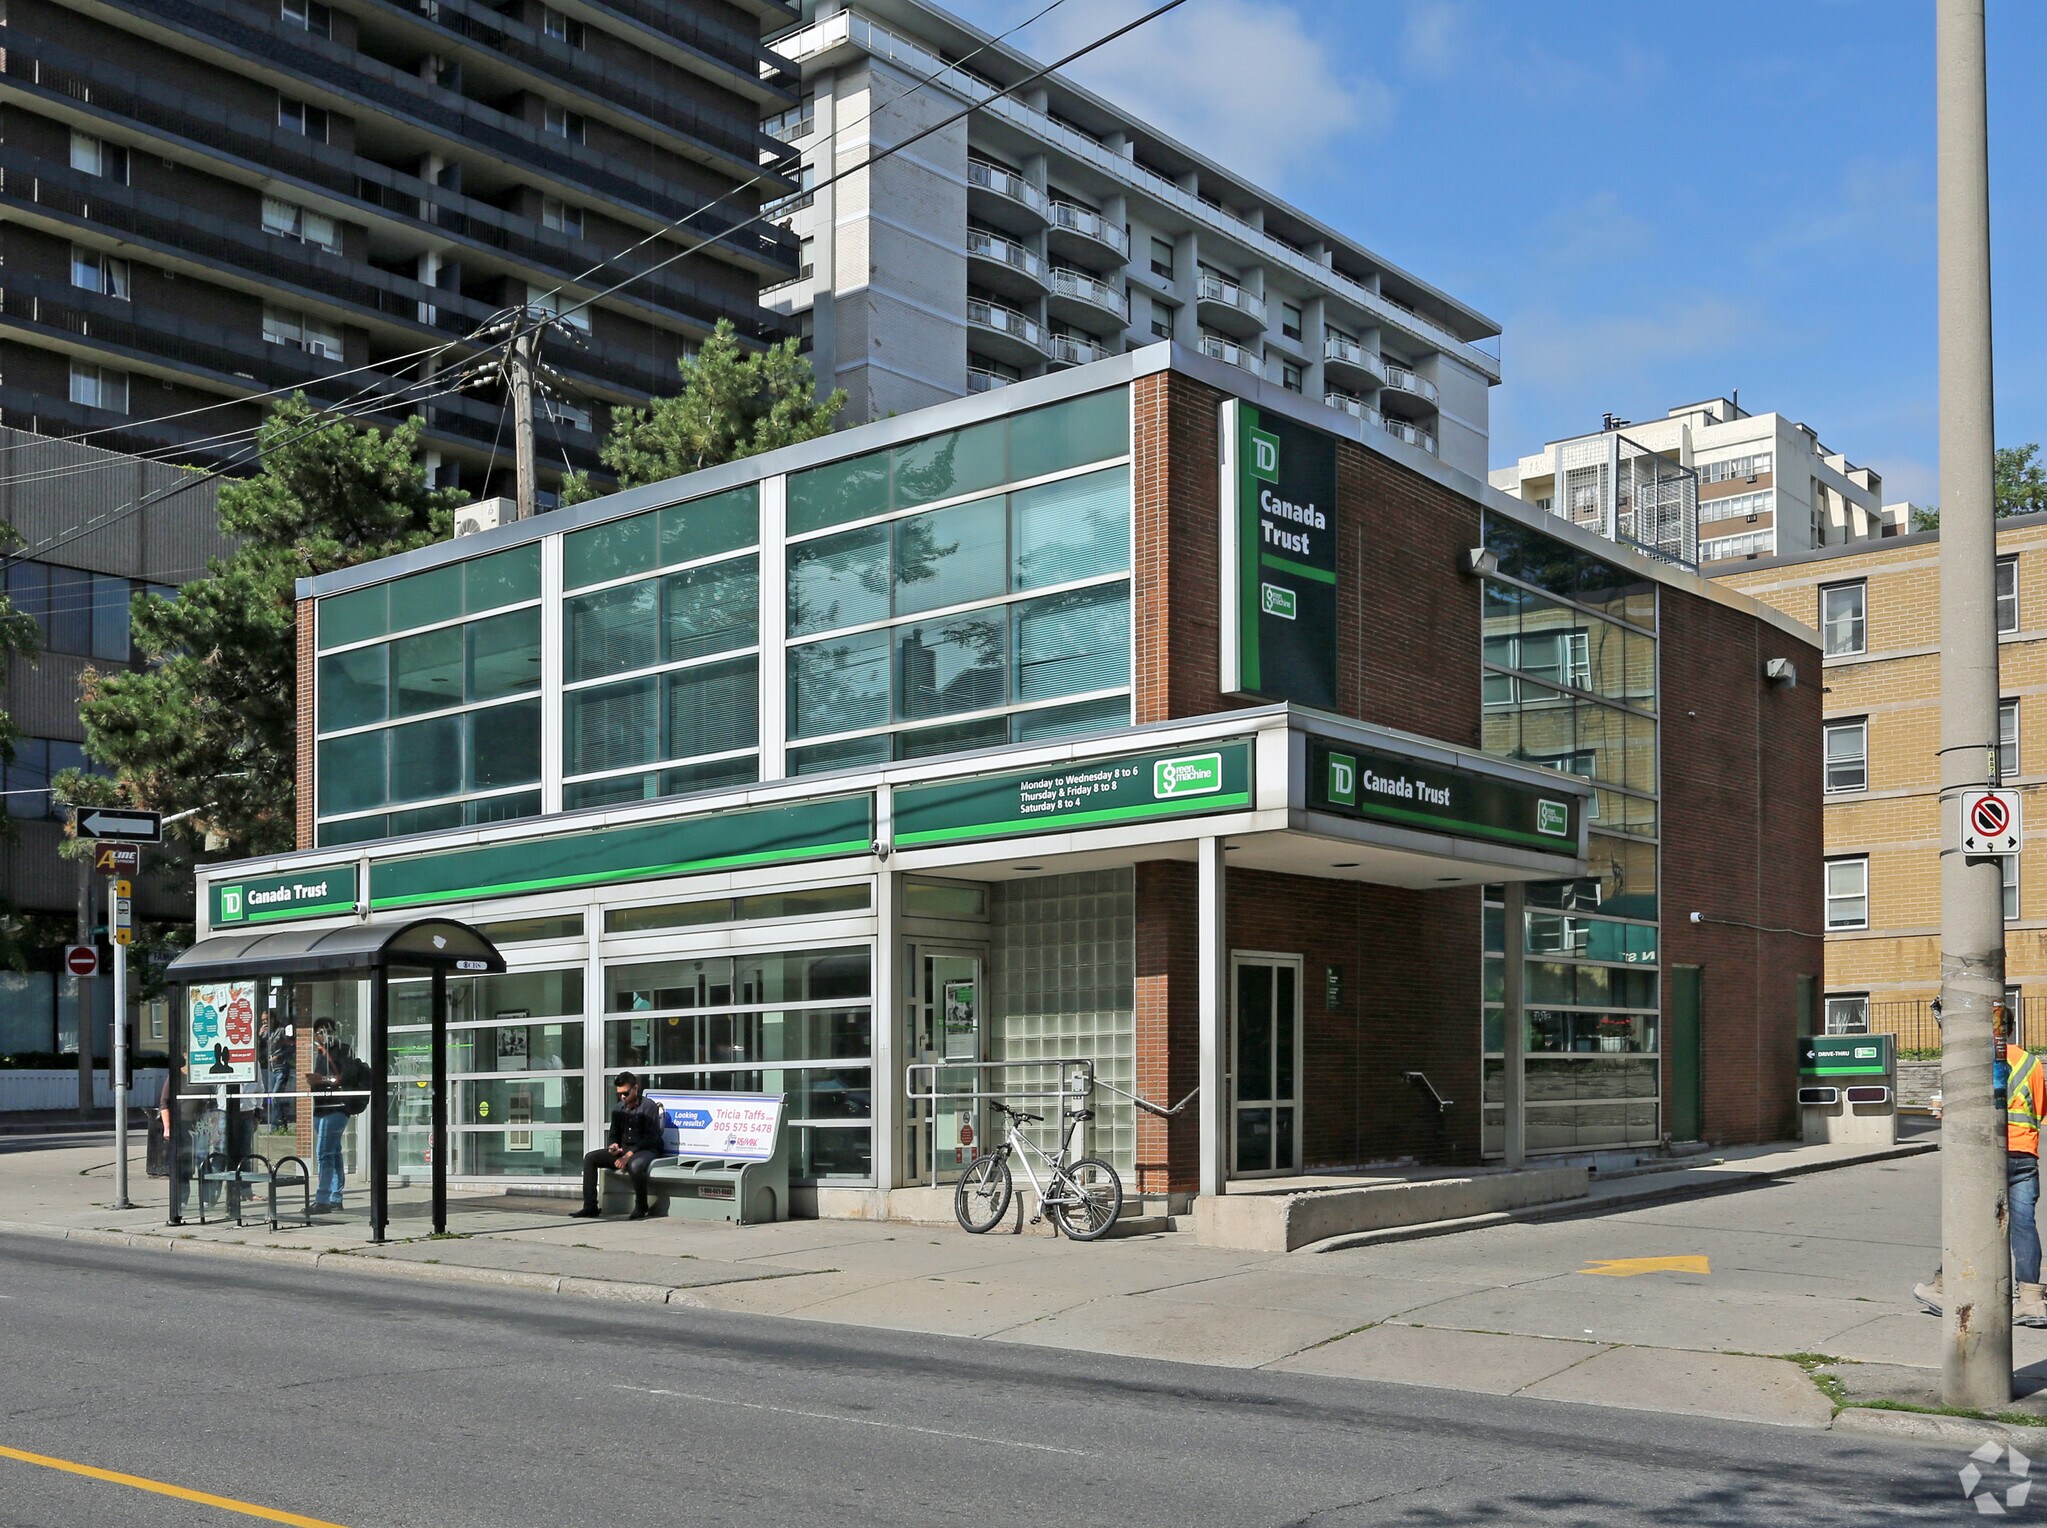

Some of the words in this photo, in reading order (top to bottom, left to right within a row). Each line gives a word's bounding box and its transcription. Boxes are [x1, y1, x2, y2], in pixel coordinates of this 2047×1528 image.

[1252, 437, 1276, 472] TD
[1260, 490, 1326, 530] Canada
[1261, 519, 1310, 555] Trust
[1020, 779, 1053, 791] Monday
[1055, 777, 1064, 786] to
[1065, 770, 1113, 784] Wednesday
[1114, 768, 1120, 778] 8
[1121, 767, 1131, 777] to
[1132, 766, 1139, 776] 6
[1175, 768, 1212, 782] machine
[1332, 762, 1353, 795] TD
[1363, 770, 1413, 799] Canada
[1416, 781, 1450, 806] Trust
[1020, 790, 1057, 802] Thursday
[1058, 788, 1065, 797] &
[1067, 784, 1092, 796] Friday
[1093, 783, 1099, 793] 8
[1101, 782, 1110, 791] to
[1111, 781, 1117, 790] 8
[1020, 801, 1056, 813] Saturday
[1057, 800, 1063, 809] 8
[1064, 798, 1074, 808] to
[1074, 797, 1081, 807] 4
[96, 850, 115, 868] A
[223, 893, 240, 914] TD
[248, 885, 291, 905] Canada
[293, 881, 327, 899] Trust
[674, 1111, 698, 1119] Looking
[716, 1109, 741, 1119] Tricia
[713, 1122, 731, 1132] 905
[733, 1123, 748, 1132] 575
[751, 1123, 773, 1133] 5478
